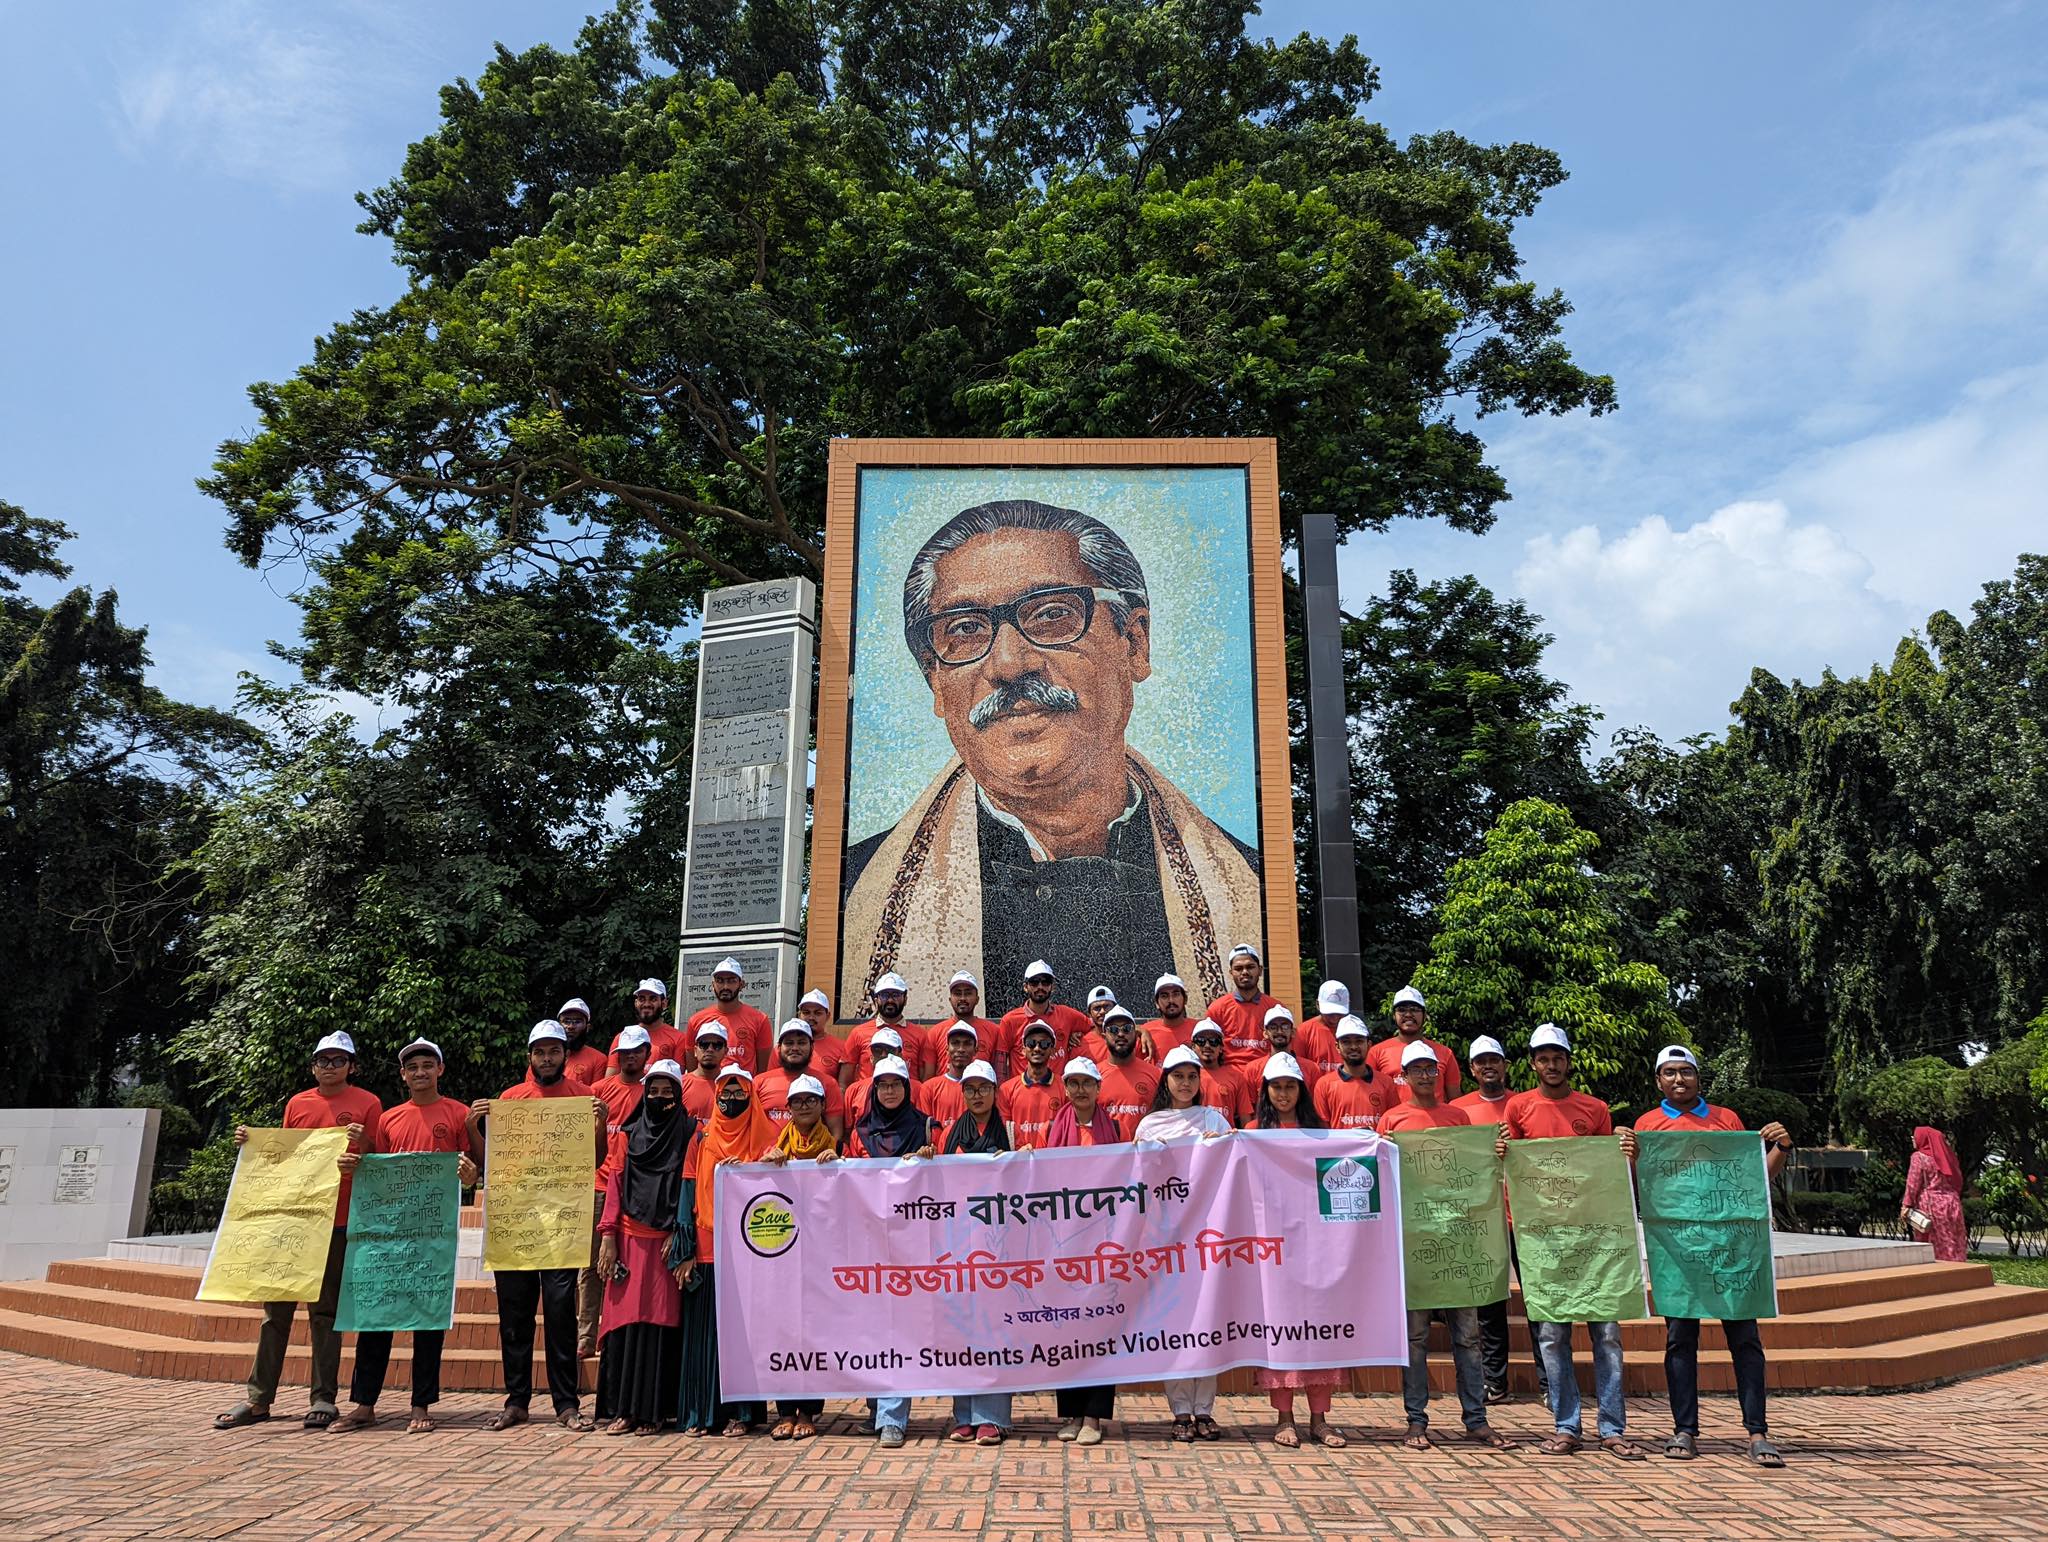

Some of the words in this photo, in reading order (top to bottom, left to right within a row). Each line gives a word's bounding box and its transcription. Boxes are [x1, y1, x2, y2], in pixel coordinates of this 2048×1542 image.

[751, 979, 771, 990] হামিদ
[1656, 1144, 1742, 1180] সামাজিক
[751, 1208, 790, 1225] Save
[893, 1195, 956, 1221] শান্তির
[967, 1182, 1148, 1225] বাংলাদেশ
[1153, 1176, 1190, 1203] গড়ি
[832, 1250, 1045, 1297] আন্তর্জাতিক
[1053, 1240, 1187, 1285] অহিংসা
[1195, 1228, 1285, 1271] দিবস
[1003, 1313, 1013, 1325] ২
[1017, 1305, 1081, 1323] অক্টোবর
[1085, 1303, 1125, 1318] ২০২৩
[769, 1352, 828, 1372] SAVE
[834, 1348, 913, 1371] Youth-
[919, 1346, 1024, 1368] Students
[1030, 1337, 1117, 1368] Against
[1122, 1327, 1223, 1355] Violence
[1227, 1319, 1356, 1346] Everywhere
